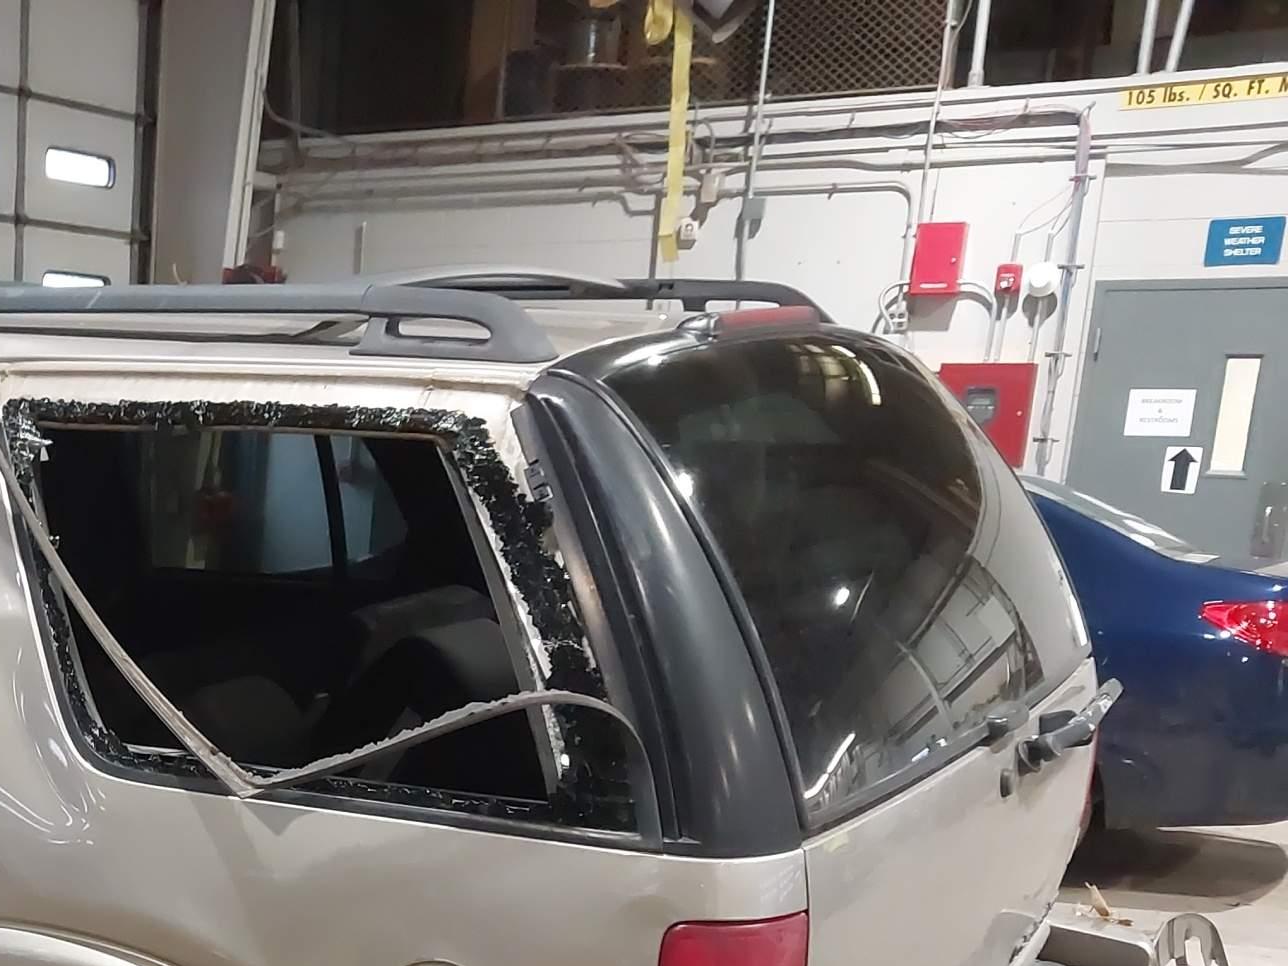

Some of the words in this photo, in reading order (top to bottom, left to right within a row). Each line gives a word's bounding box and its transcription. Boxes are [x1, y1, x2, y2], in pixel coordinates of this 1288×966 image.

[1128, 89, 1155, 105] 105
[1162, 86, 1190, 103] lbs.
[1198, 83, 1207, 100] /
[1213, 83, 1238, 99] SQ.
[1247, 79, 1269, 96] FT.
[1228, 225, 1264, 235] SEVERE
[1223, 236, 1265, 246] WEATHER
[1223, 247, 1262, 257] SHELTER
